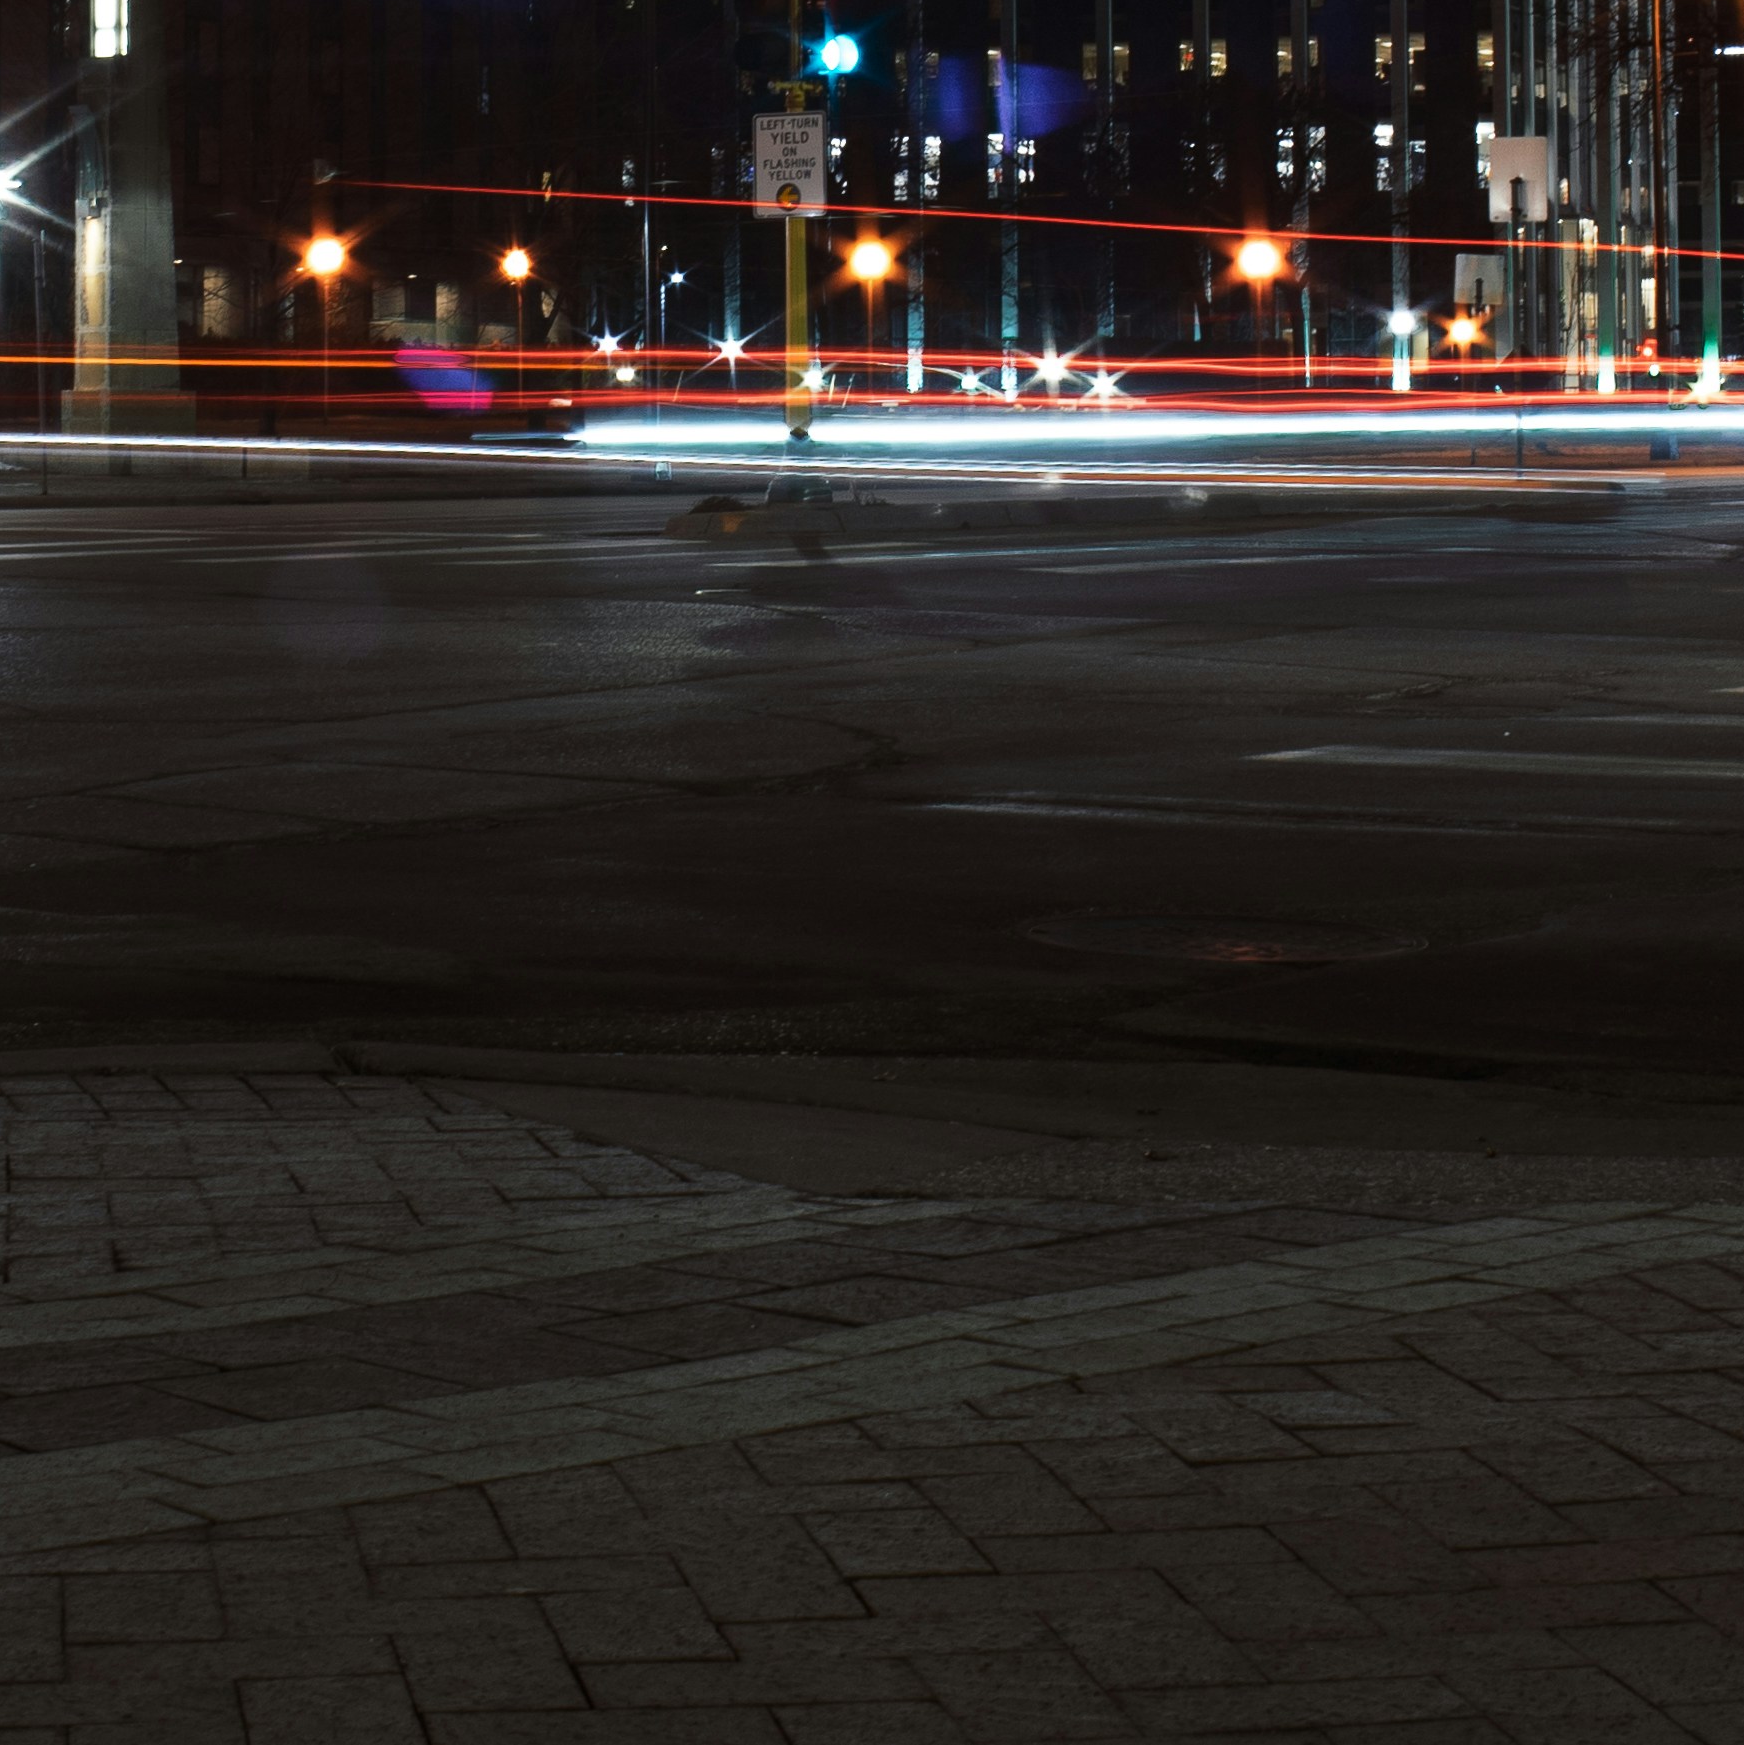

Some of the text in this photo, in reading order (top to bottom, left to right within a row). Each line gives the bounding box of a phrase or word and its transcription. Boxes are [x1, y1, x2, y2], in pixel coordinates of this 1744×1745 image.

[760, 117, 818, 130] LEFT-TURN
[771, 131, 809, 145] YIELD
[782, 146, 797, 157] ON
[763, 157, 816, 169] FLASHING
[769, 170, 811, 181] YELLOW
